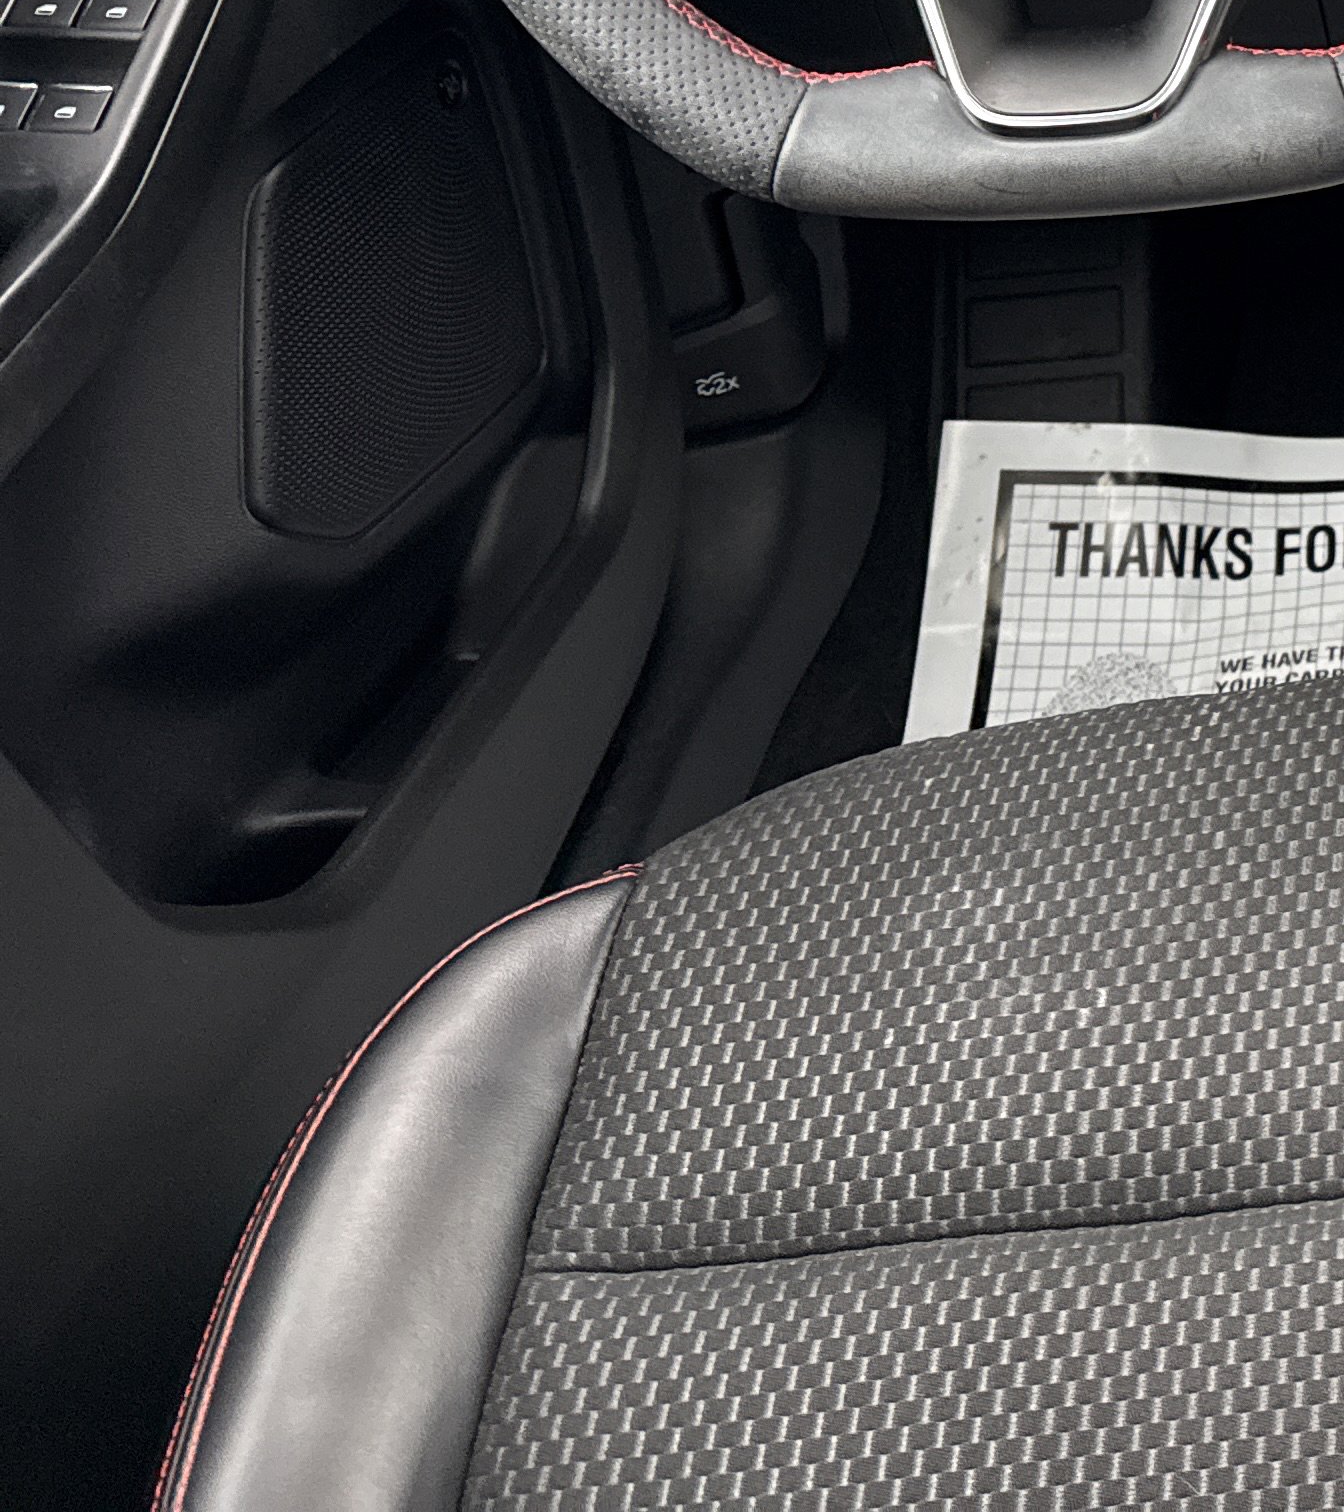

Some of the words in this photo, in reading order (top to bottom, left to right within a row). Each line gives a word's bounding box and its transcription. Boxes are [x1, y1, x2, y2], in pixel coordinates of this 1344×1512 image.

[1049, 521, 1252, 581] THANKS
[1220, 656, 1254, 675] WE
[1261, 648, 1318, 671] HAVE
